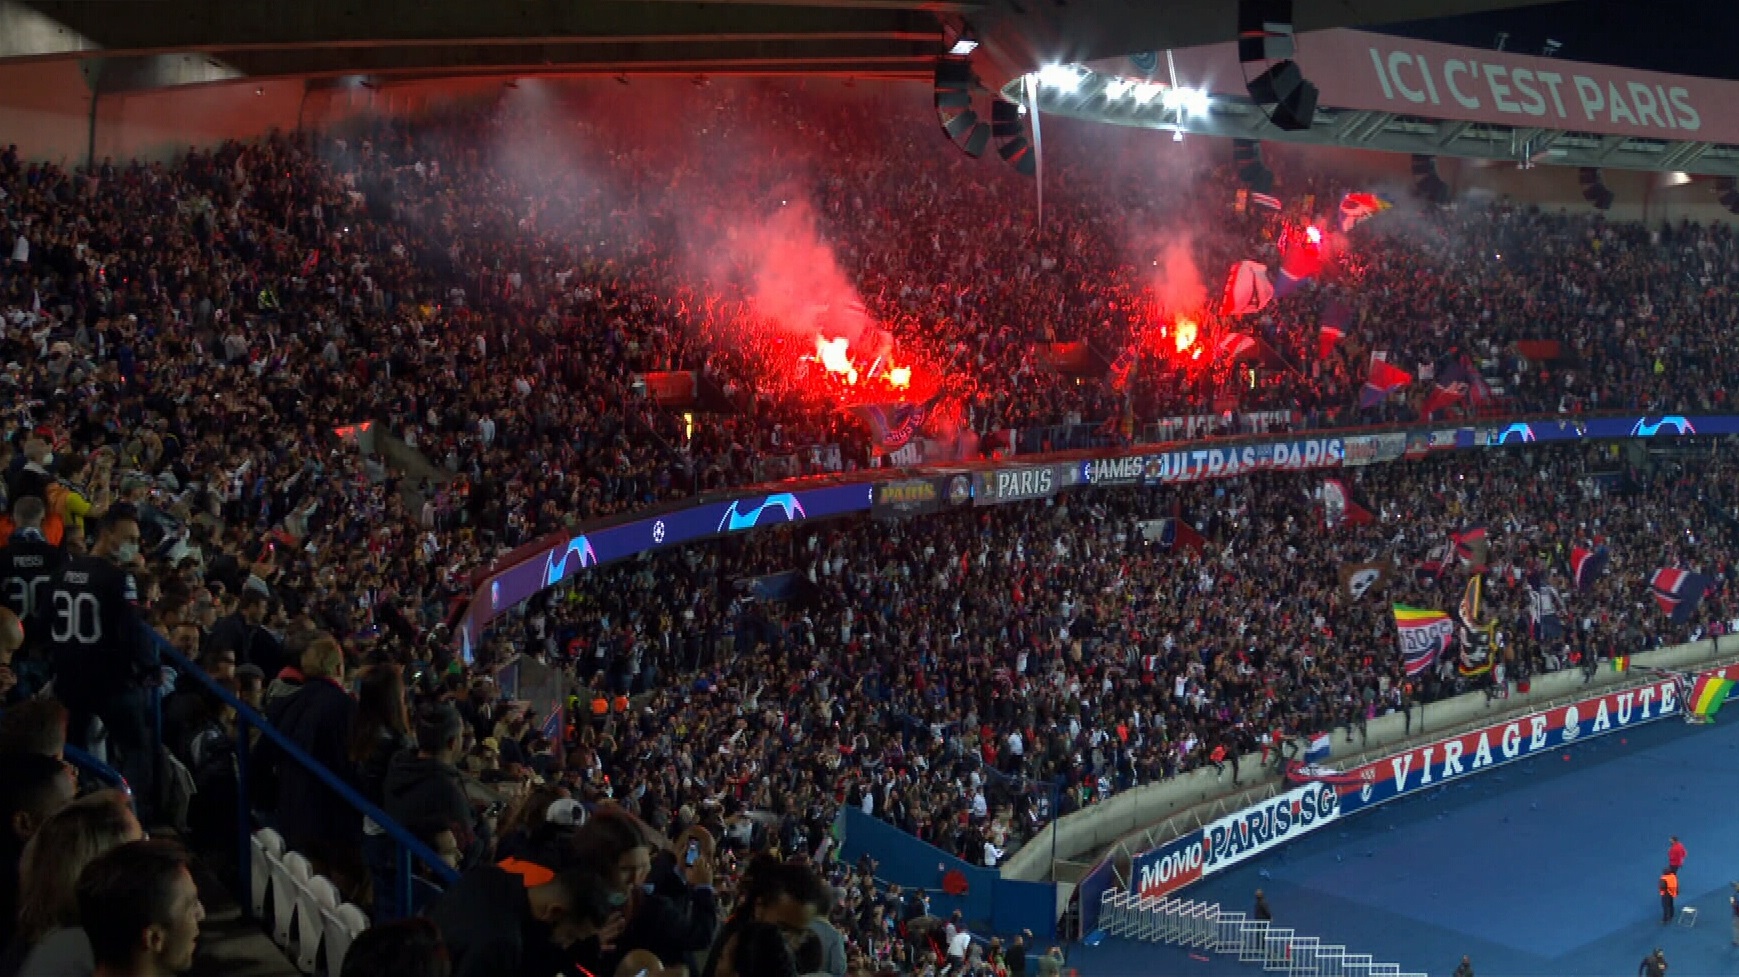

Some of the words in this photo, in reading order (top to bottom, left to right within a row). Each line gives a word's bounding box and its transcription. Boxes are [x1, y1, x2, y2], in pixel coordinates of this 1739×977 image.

[1369, 48, 1440, 105] ICI
[1443, 59, 1567, 118] C'EST
[1573, 75, 1700, 130] PARIS
[998, 468, 1052, 498] PARIS
[1091, 456, 1143, 484] JAMES
[1162, 447, 1255, 481] ULTRAS
[1273, 438, 1341, 470] PARIS
[50, 590, 103, 644] 30
[1391, 718, 1548, 792] VIRAGE
[1141, 841, 1203, 892] MOMO
[1208, 799, 1292, 865] PARIS
[1300, 782, 1338, 828] SG
